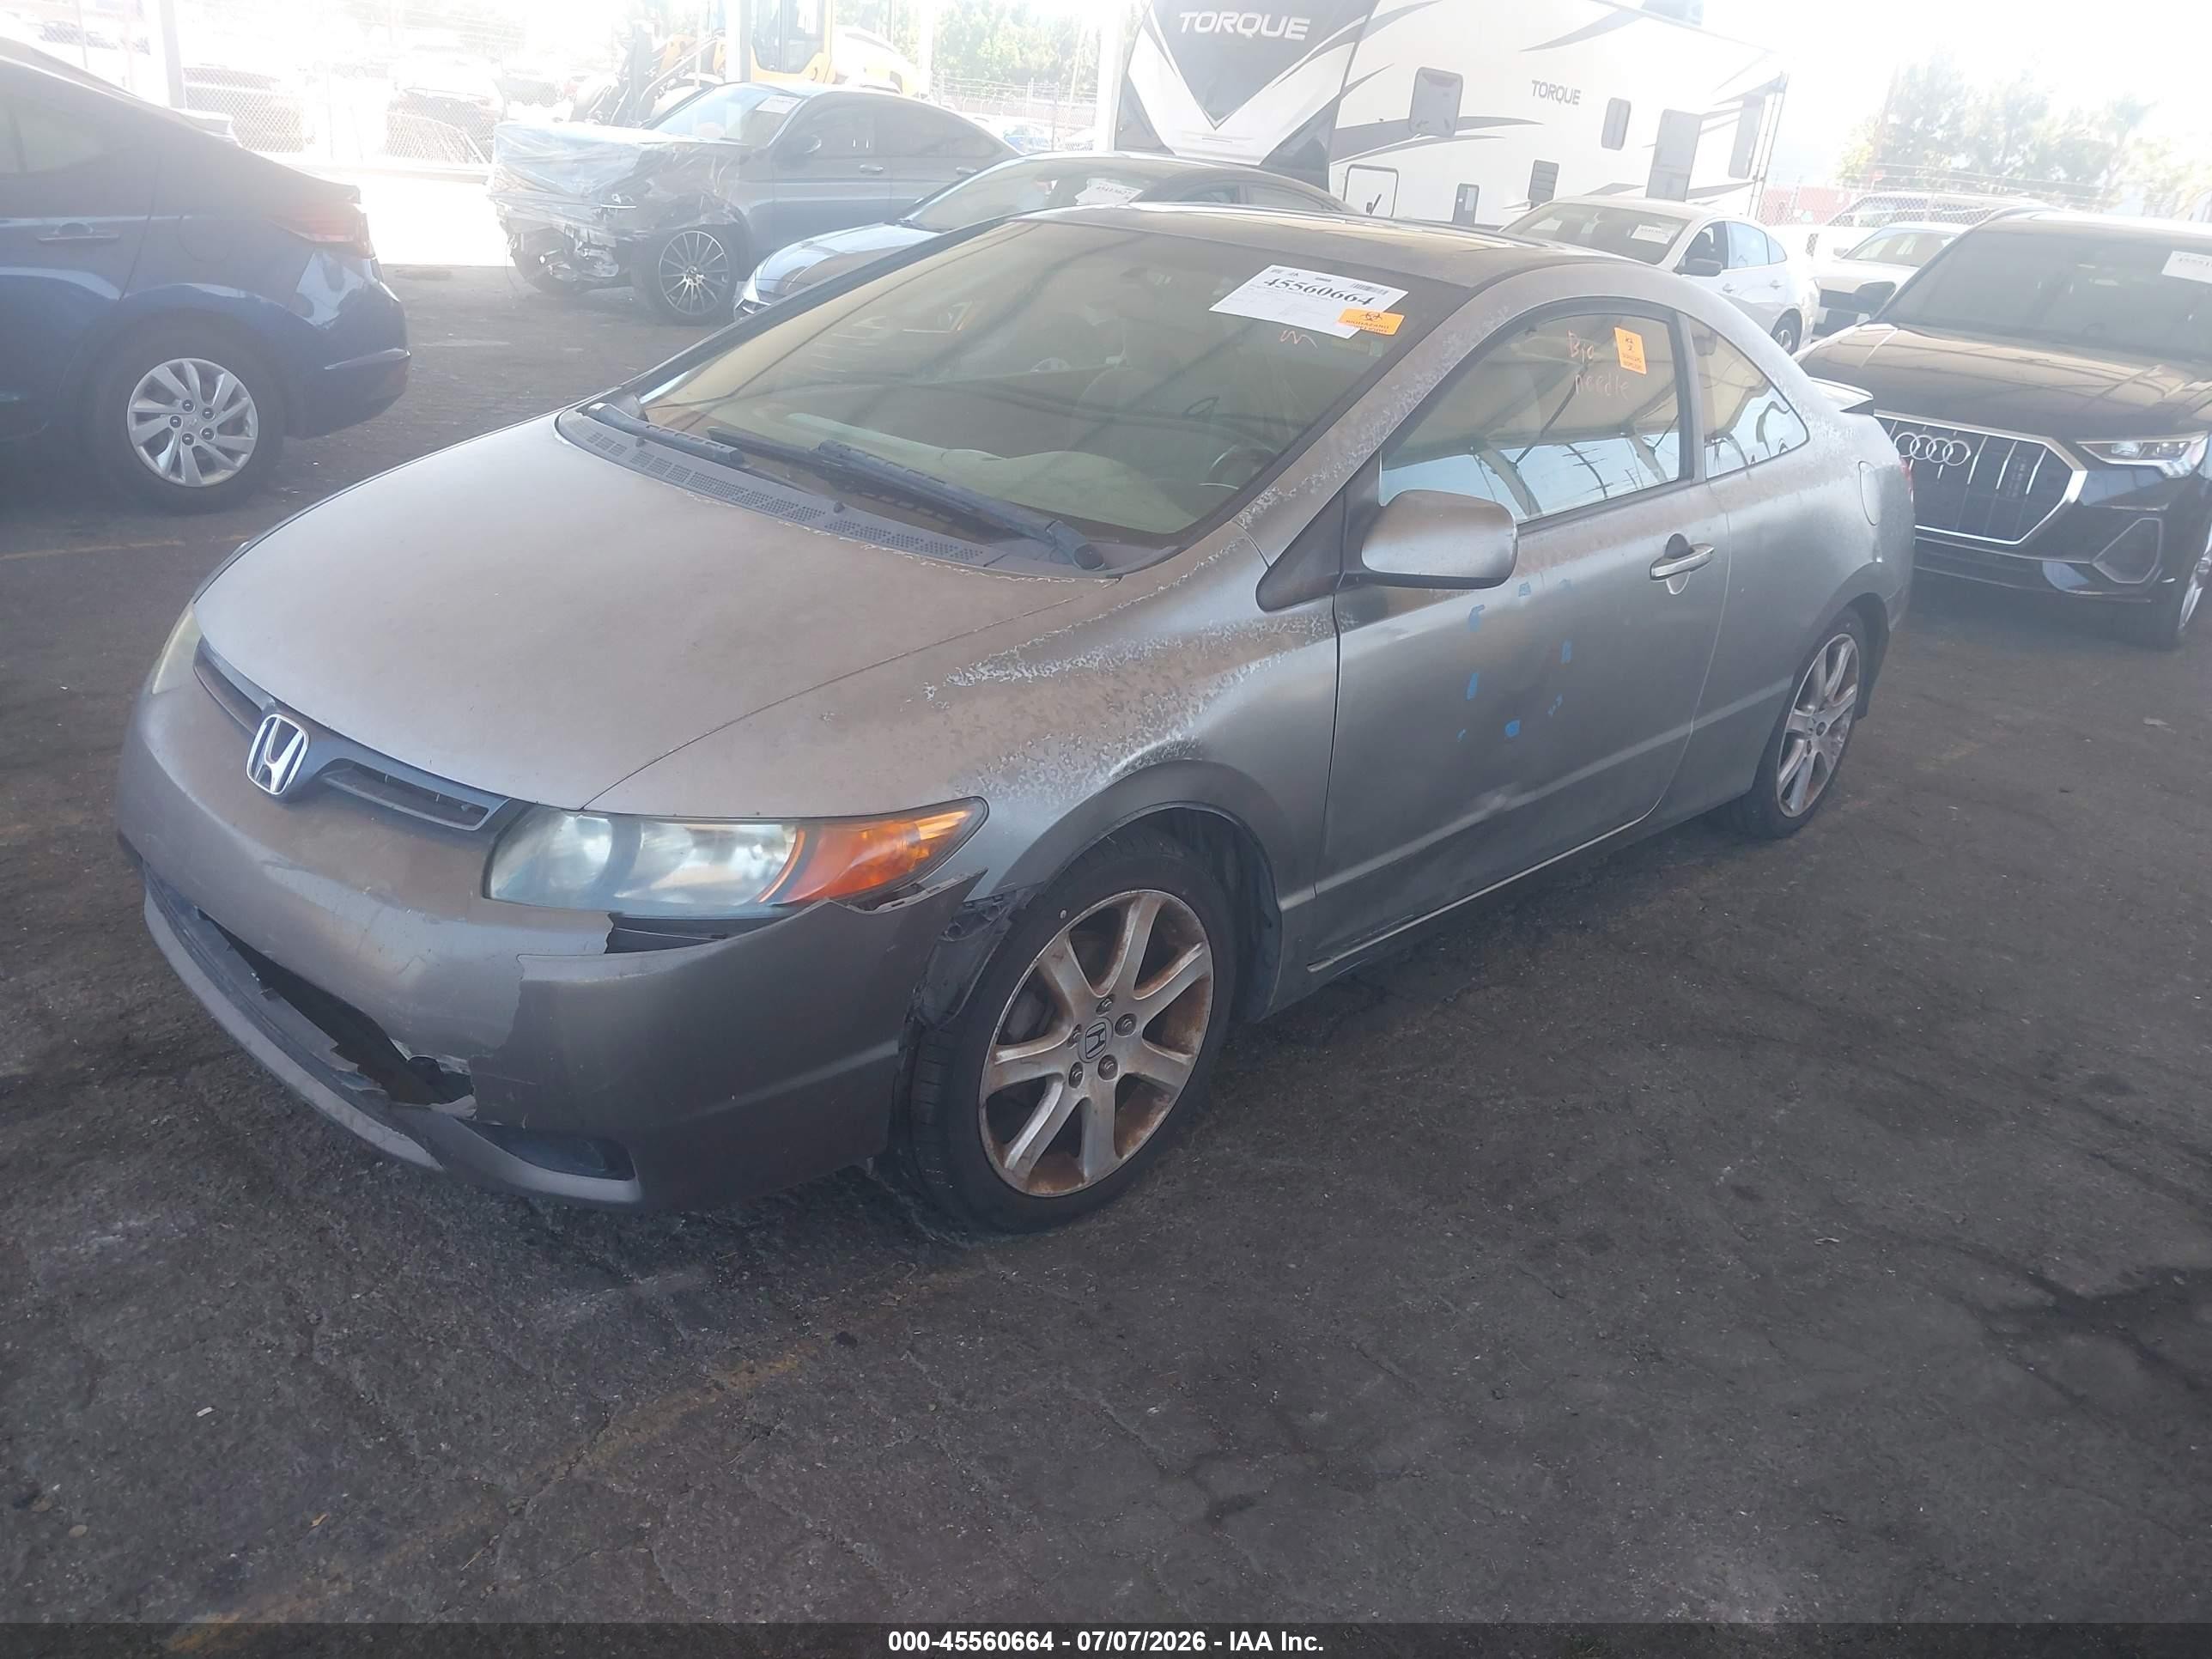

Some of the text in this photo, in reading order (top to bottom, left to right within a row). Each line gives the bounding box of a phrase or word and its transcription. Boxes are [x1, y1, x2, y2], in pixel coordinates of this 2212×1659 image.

[1179, 11, 1311, 41] TORQUE
[1531, 80, 1582, 105] TORQUE
[1263, 278, 1376, 306] 45560664
